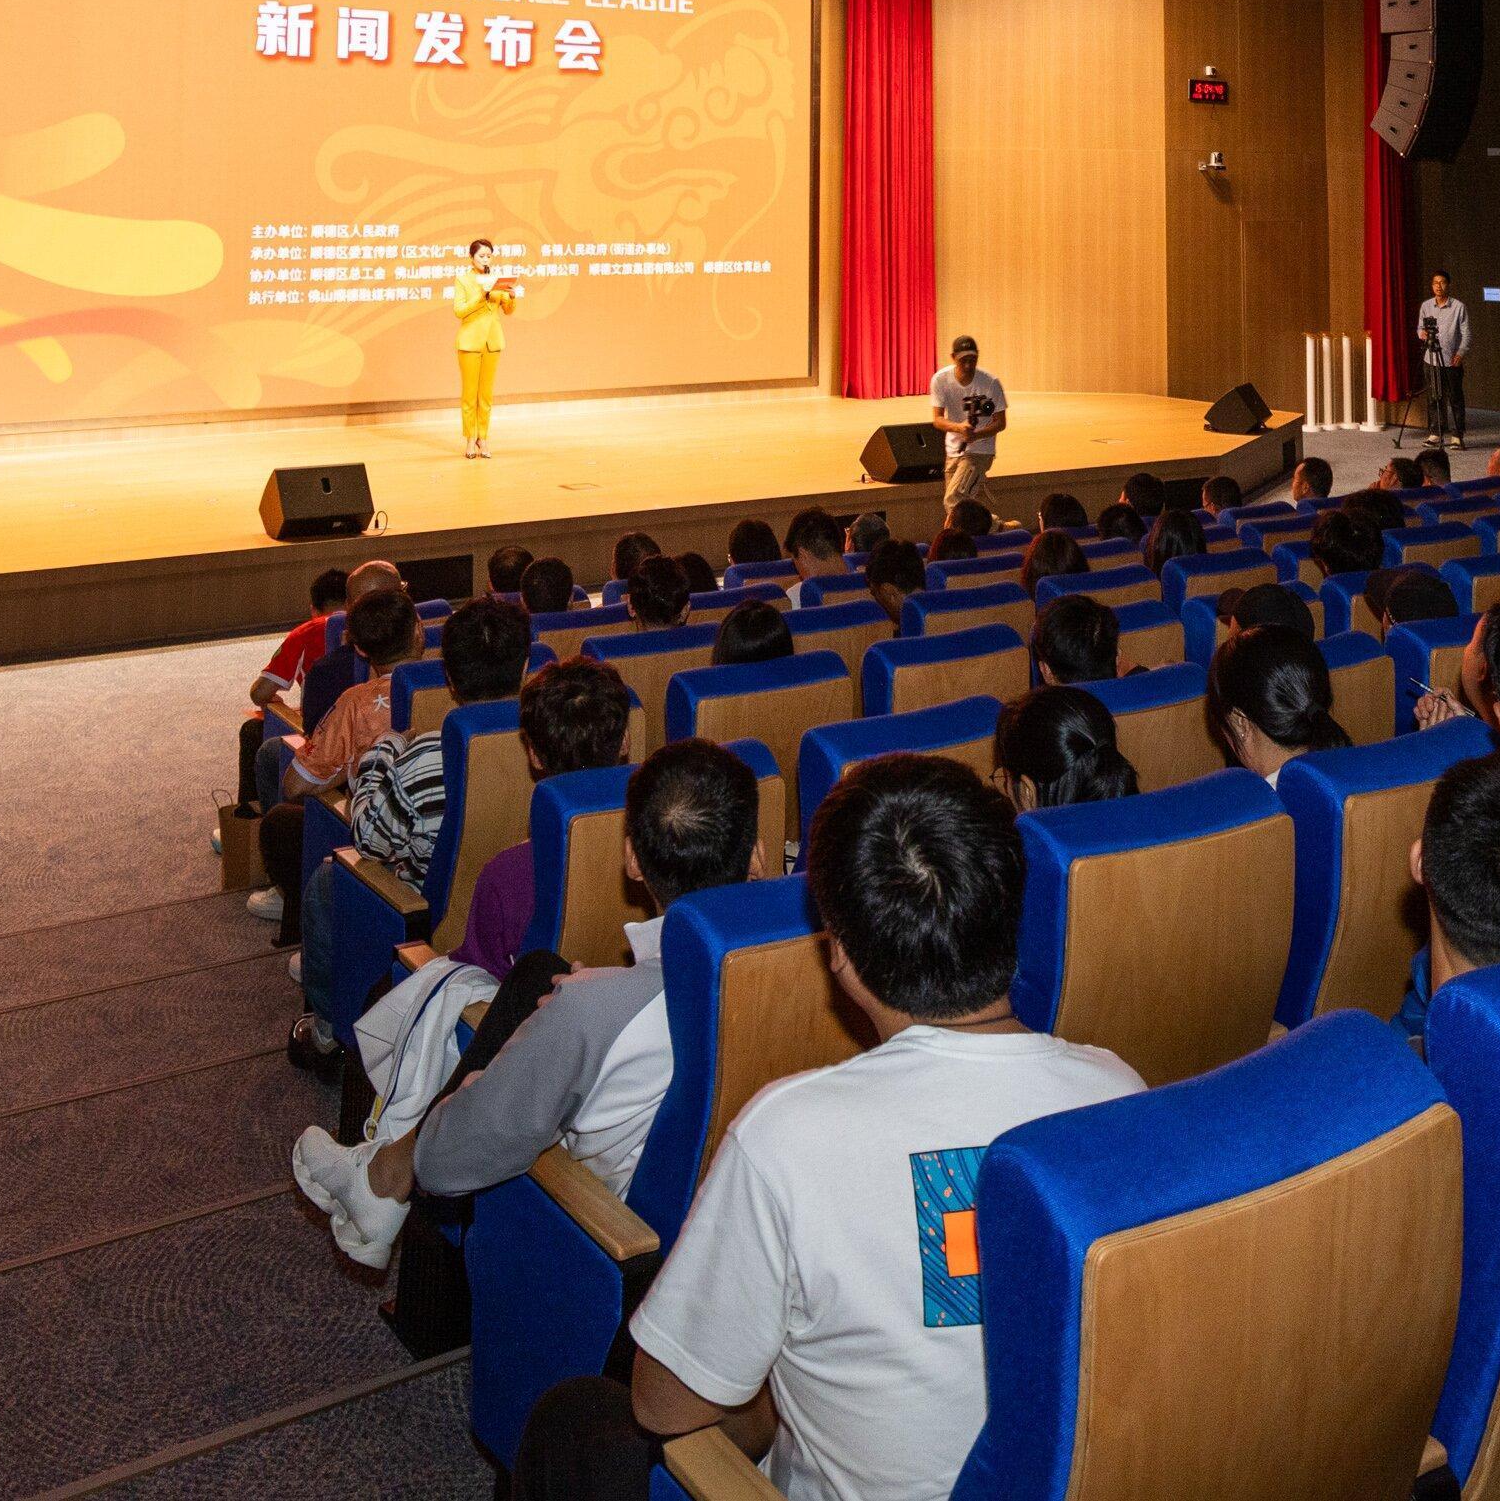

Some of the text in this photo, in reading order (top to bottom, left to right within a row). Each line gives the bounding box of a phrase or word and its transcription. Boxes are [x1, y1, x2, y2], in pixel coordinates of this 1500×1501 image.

[256, 0, 603, 72] 新闻发布会
